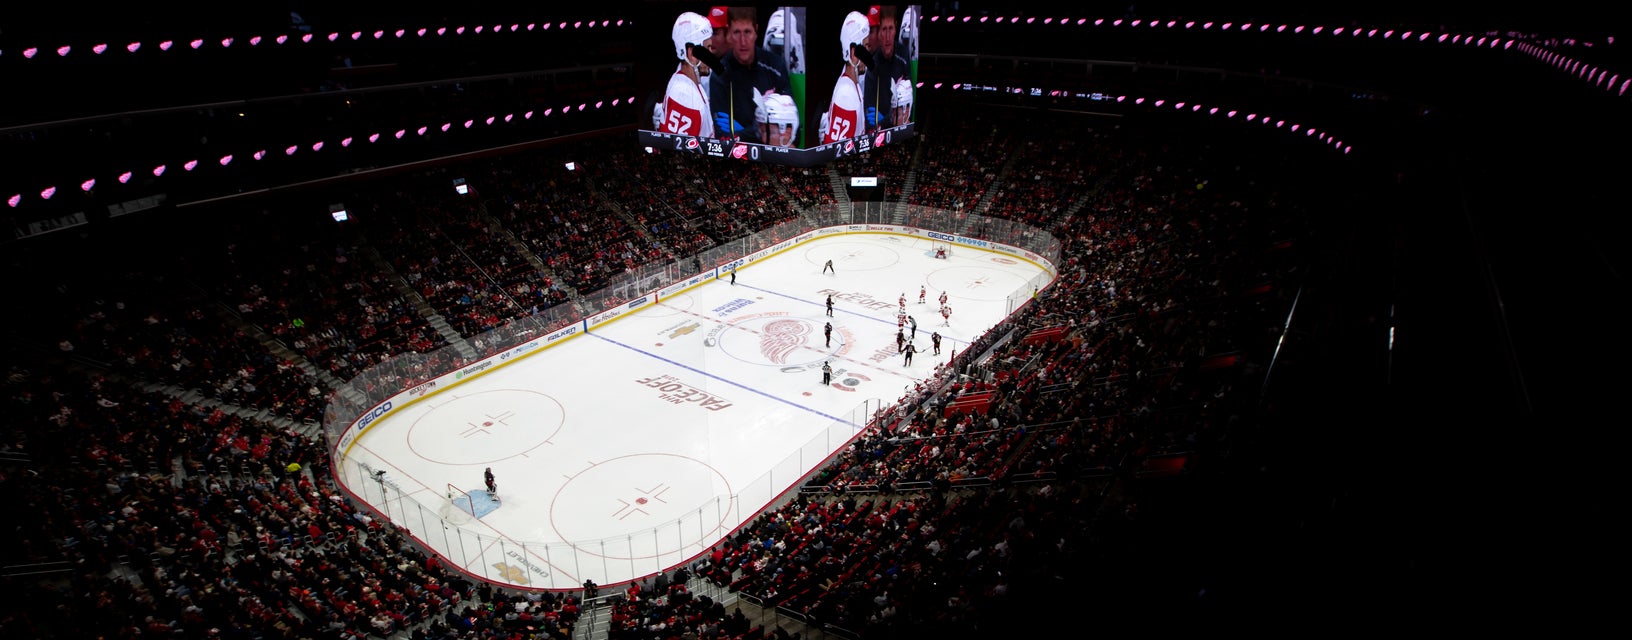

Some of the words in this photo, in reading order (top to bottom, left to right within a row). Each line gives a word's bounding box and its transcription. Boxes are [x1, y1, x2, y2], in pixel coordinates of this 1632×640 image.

[668, 110, 693, 136] 52
[830, 116, 850, 141] 52
[676, 136, 682, 150] 2
[707, 142, 722, 152] 7:36
[752, 146, 758, 160] 0
[928, 232, 954, 242] GEICO
[548, 326, 576, 342] FALKEN
[463, 360, 492, 376] Huntington
[358, 402, 392, 430] GEICO
